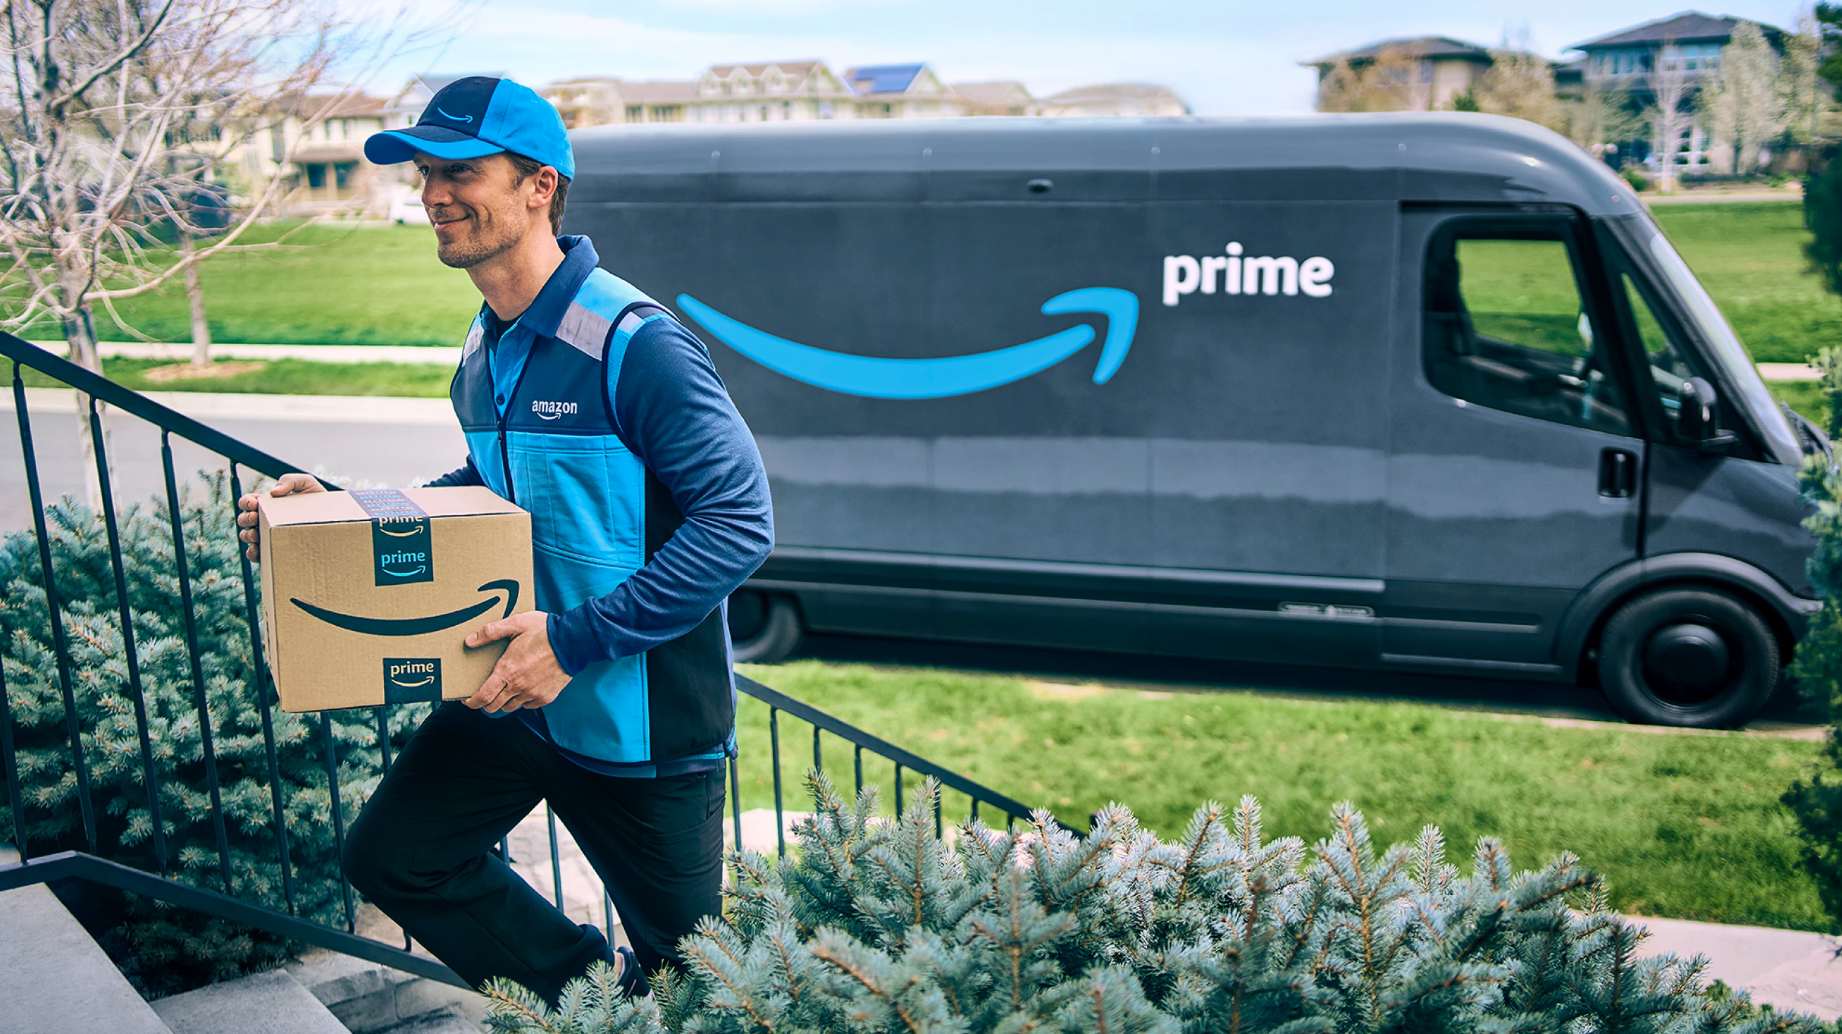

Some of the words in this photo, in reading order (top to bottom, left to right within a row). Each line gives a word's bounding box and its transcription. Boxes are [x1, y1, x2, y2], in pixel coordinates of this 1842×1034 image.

[1162, 241, 1335, 306] prime
[531, 400, 578, 414] amazon
[381, 550, 426, 567] prime
[390, 661, 434, 678] prime
